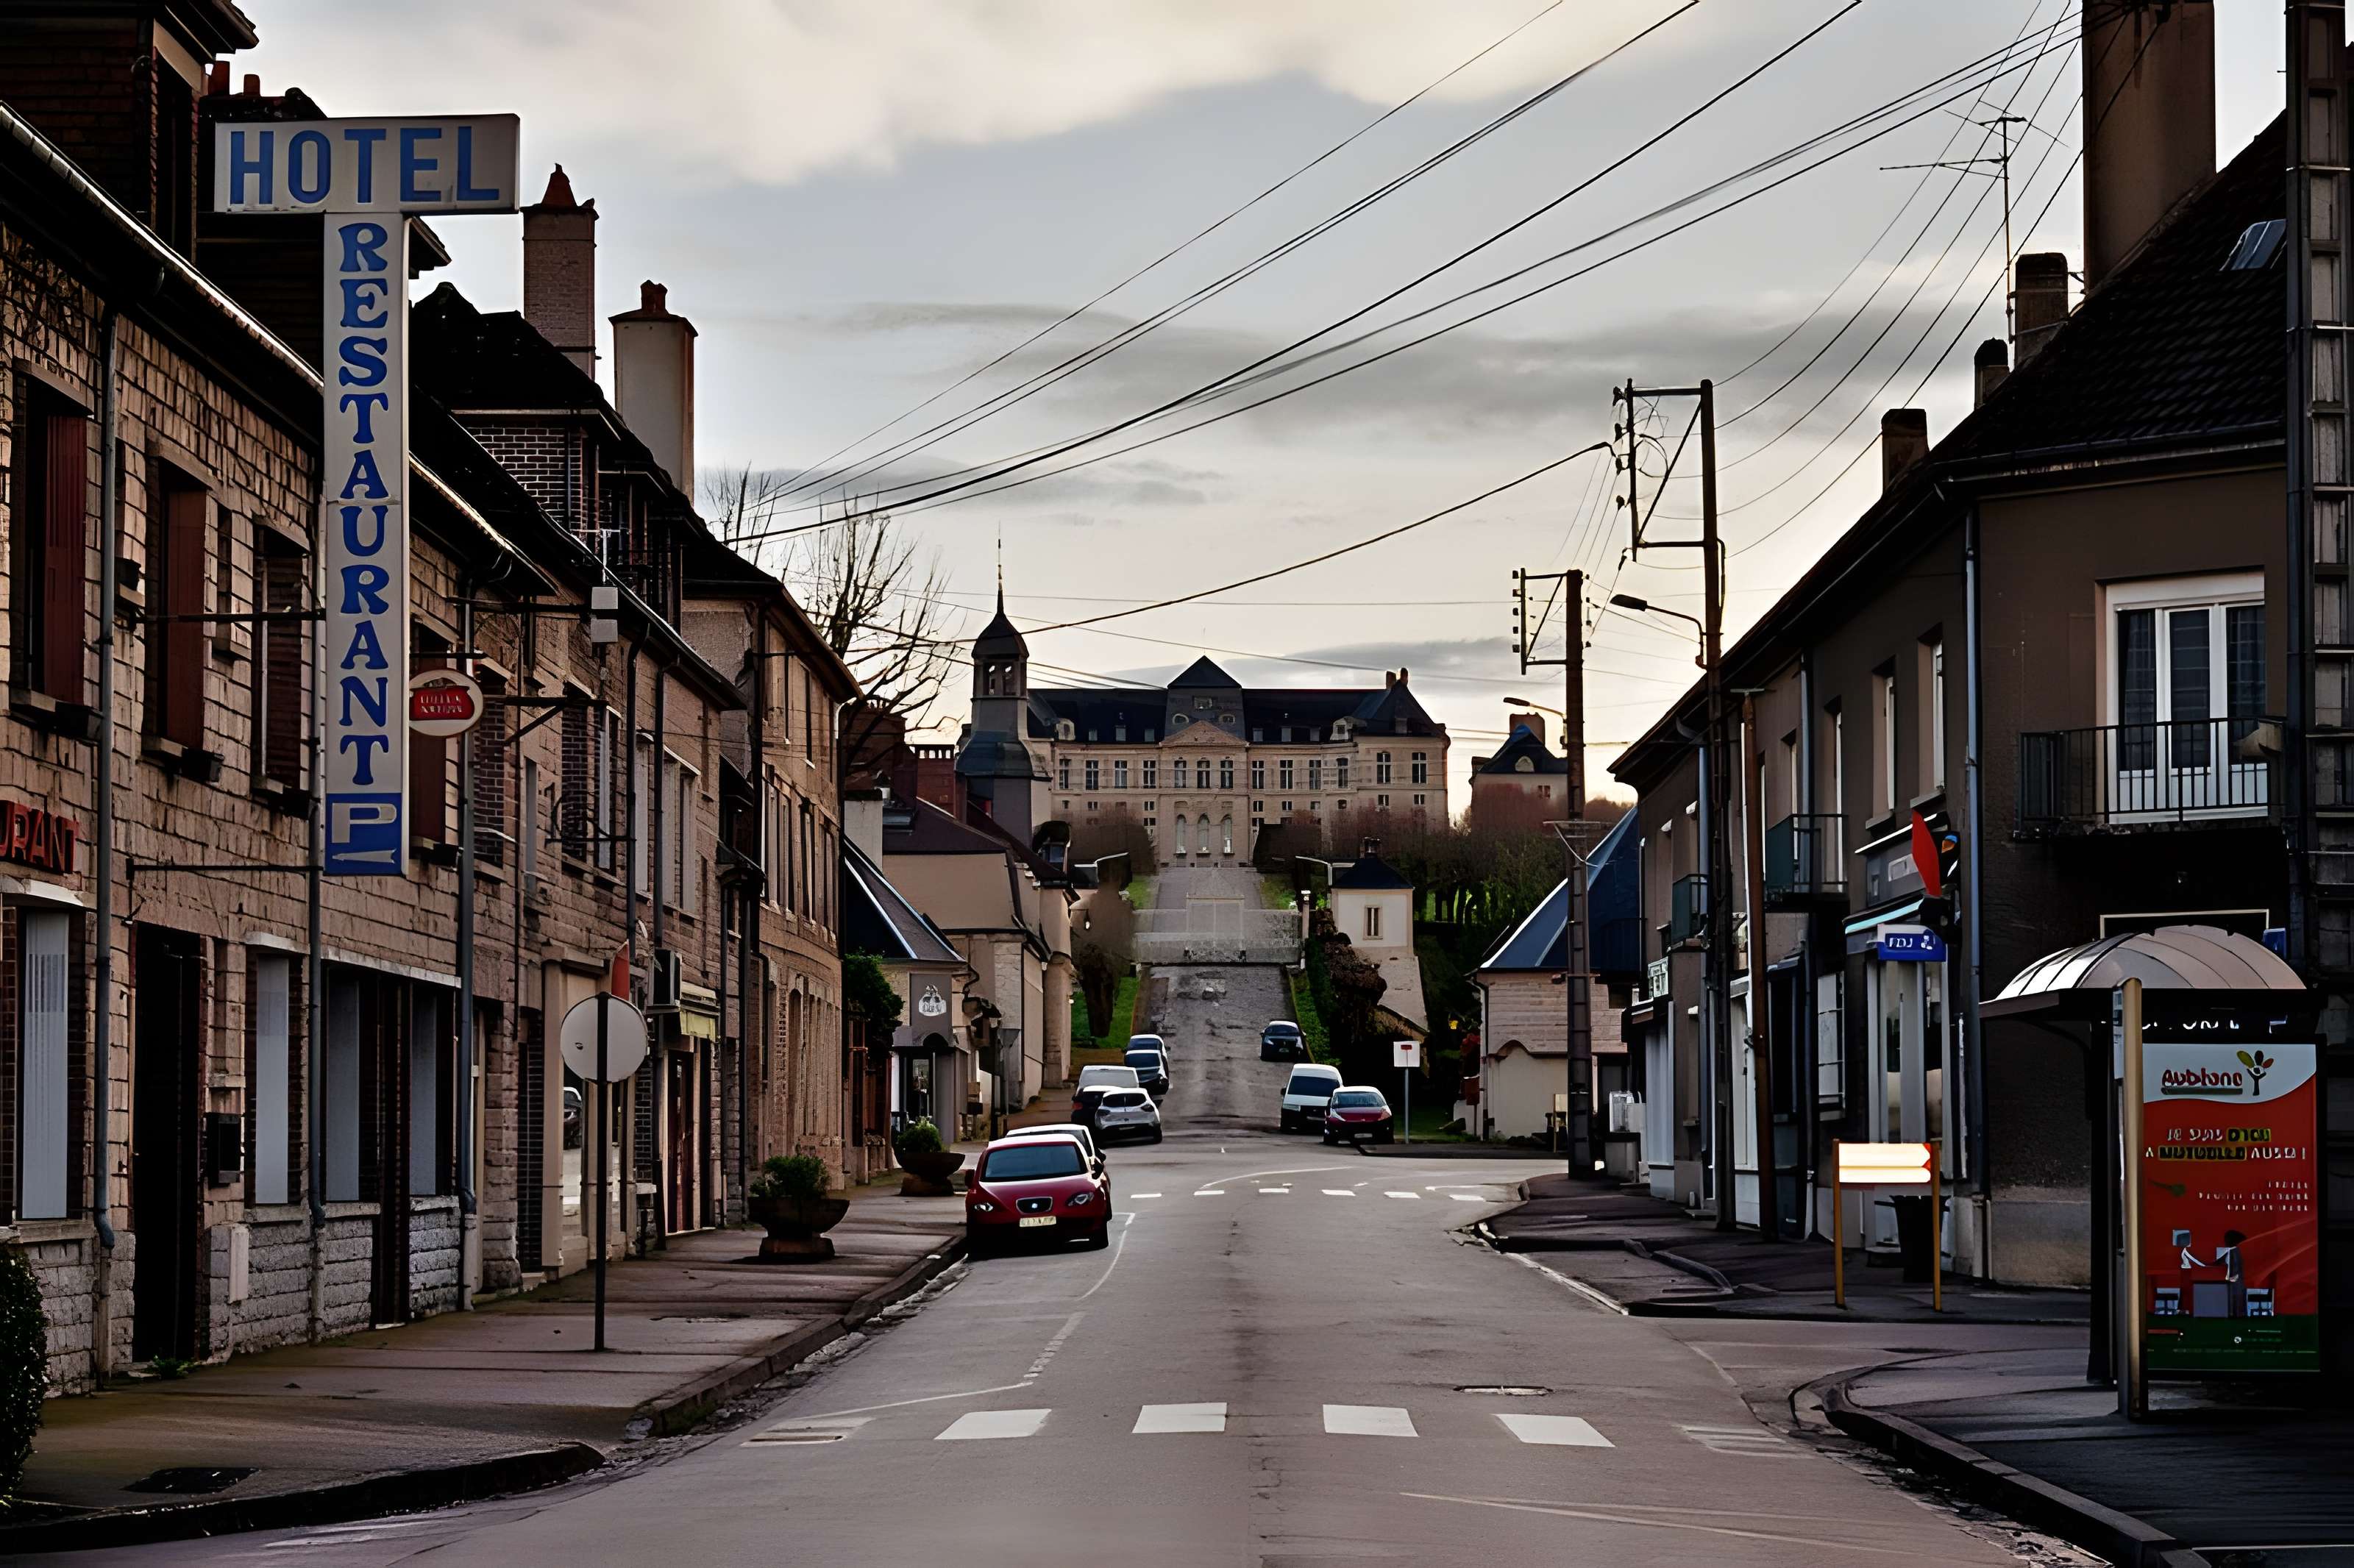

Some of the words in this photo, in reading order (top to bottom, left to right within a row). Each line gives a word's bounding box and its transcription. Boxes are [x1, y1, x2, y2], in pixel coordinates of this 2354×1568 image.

[230, 125, 499, 205] HOTEL
[338, 222, 390, 785] RESTAURANT
[332, 802, 398, 844] P
